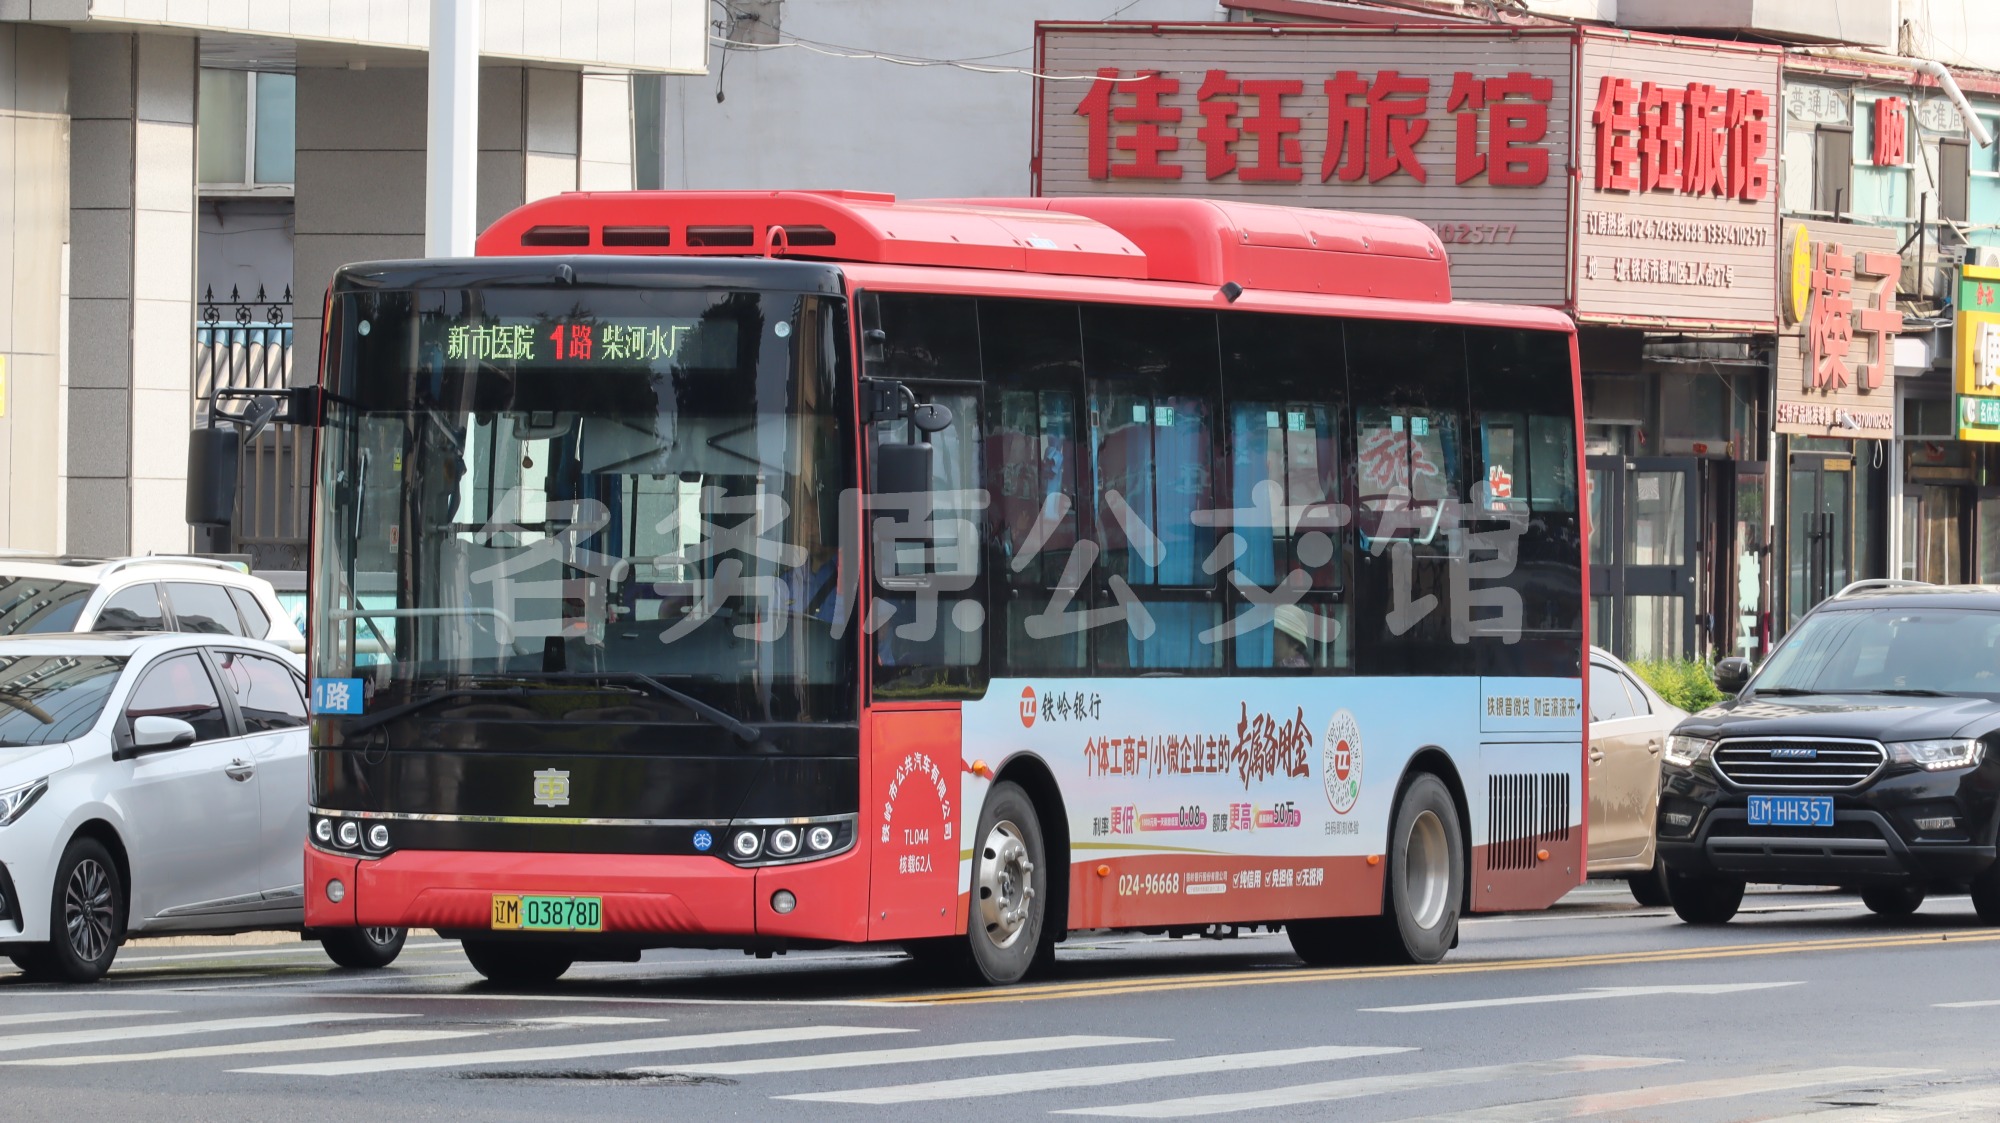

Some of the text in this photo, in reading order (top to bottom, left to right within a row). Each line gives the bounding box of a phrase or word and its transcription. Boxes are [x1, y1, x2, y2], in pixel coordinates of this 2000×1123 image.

[1790, 86, 1840, 118] 普通间
[1077, 67, 1553, 186] 佳钰旅馆
[1593, 76, 1770, 200] 佳钰旅馆
[1706, 223, 1769, 247] 13394102577
[1805, 241, 1903, 390] 榛子
[448, 325, 691, 360] 新市医院 1路 柴河水厂
[316, 682, 350, 711] 1路
[1041, 691, 1102, 722] 铁岭银行
[881, 752, 952, 843] 铁岭市公共汽车有限公司
[1750, 799, 1832, 822] 辽M·HH357
[904, 828, 929, 846] TL044
[899, 854, 933, 875] 核载62人
[1119, 872, 1180, 897] 024-96668
[1240, 869, 1262, 889] 纯信用
[1272, 868, 1294, 888] 免担保
[1302, 867, 1324, 887] 无抵押
[528, 900, 600, 926] 03878D
